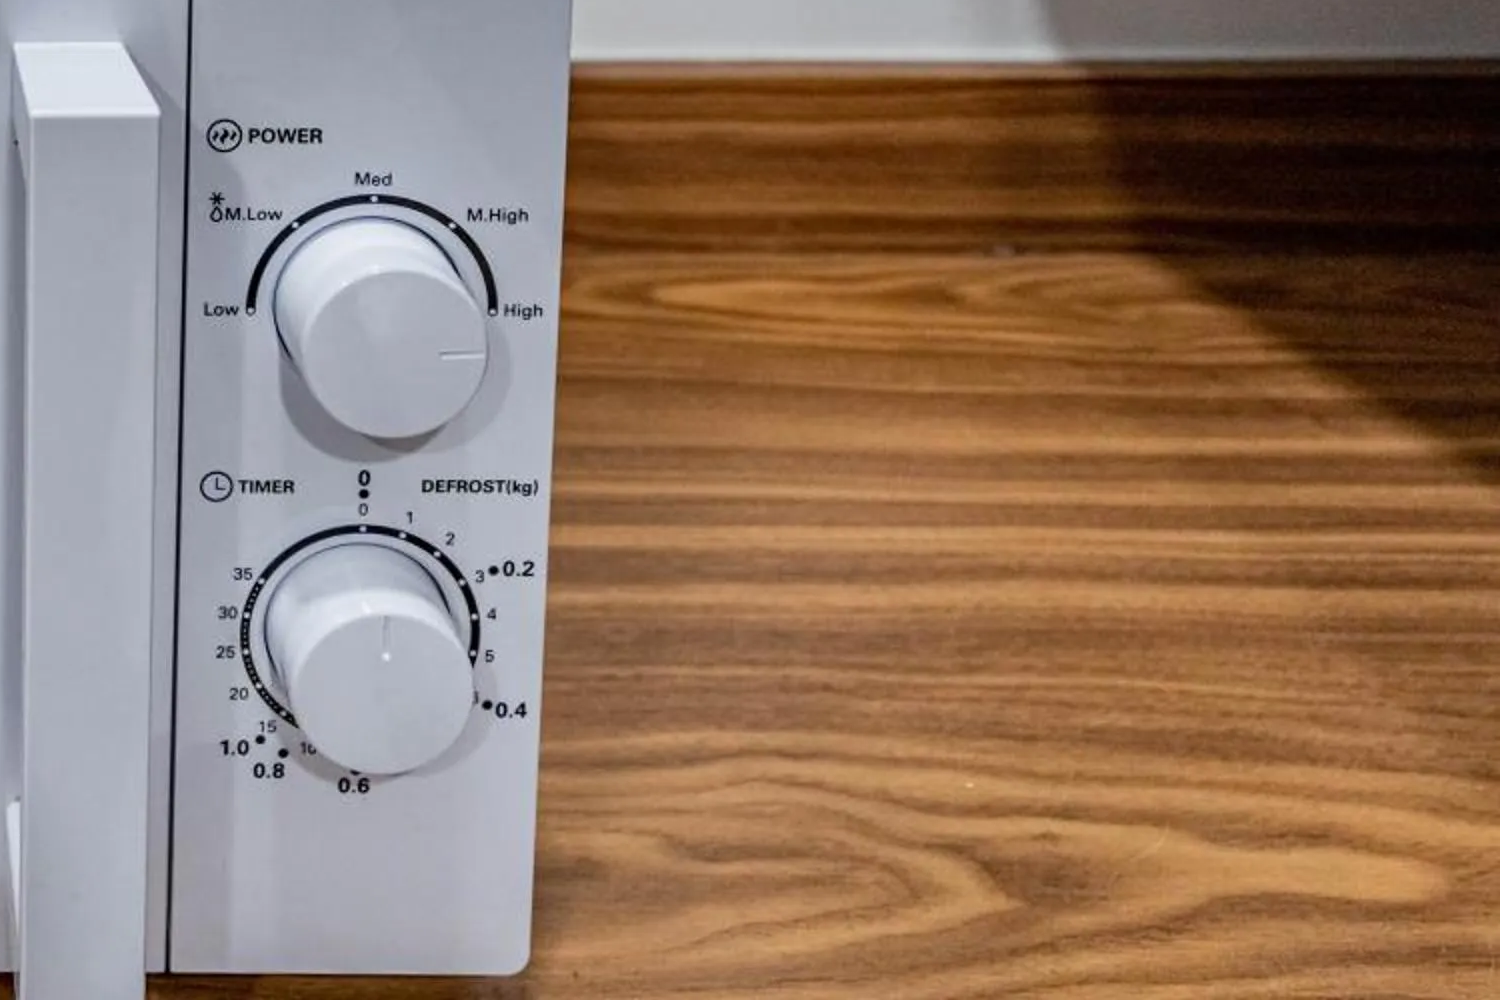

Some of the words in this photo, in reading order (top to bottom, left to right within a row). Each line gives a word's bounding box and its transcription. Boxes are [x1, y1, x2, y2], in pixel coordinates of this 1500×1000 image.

[248, 127, 323, 144] POWER
[354, 172, 393, 187] Med
[225, 207, 283, 222] M.Low
[467, 207, 529, 226] M.High
[203, 303, 239, 317] Low
[503, 303, 543, 320] High
[357, 470, 371, 487] 0
[238, 480, 295, 494] TIMER
[421, 479, 539, 497] DEFROST(kg)
[358, 503, 369, 516] 0
[406, 511, 414, 524] 1
[445, 533, 455, 546] 2
[233, 567, 253, 581] 35
[502, 561, 535, 577] 0.2
[475, 570, 485, 583] 3
[217, 607, 238, 620] 30
[487, 608, 497, 621] 4
[216, 646, 236, 659] 25
[485, 650, 495, 663] 5
[229, 687, 249, 701] 20
[495, 701, 527, 719] 0.4
[259, 720, 277, 734] 15
[220, 740, 249, 756] 1.0
[253, 763, 285, 779] 0.8
[337, 777, 370, 794] 0.6
